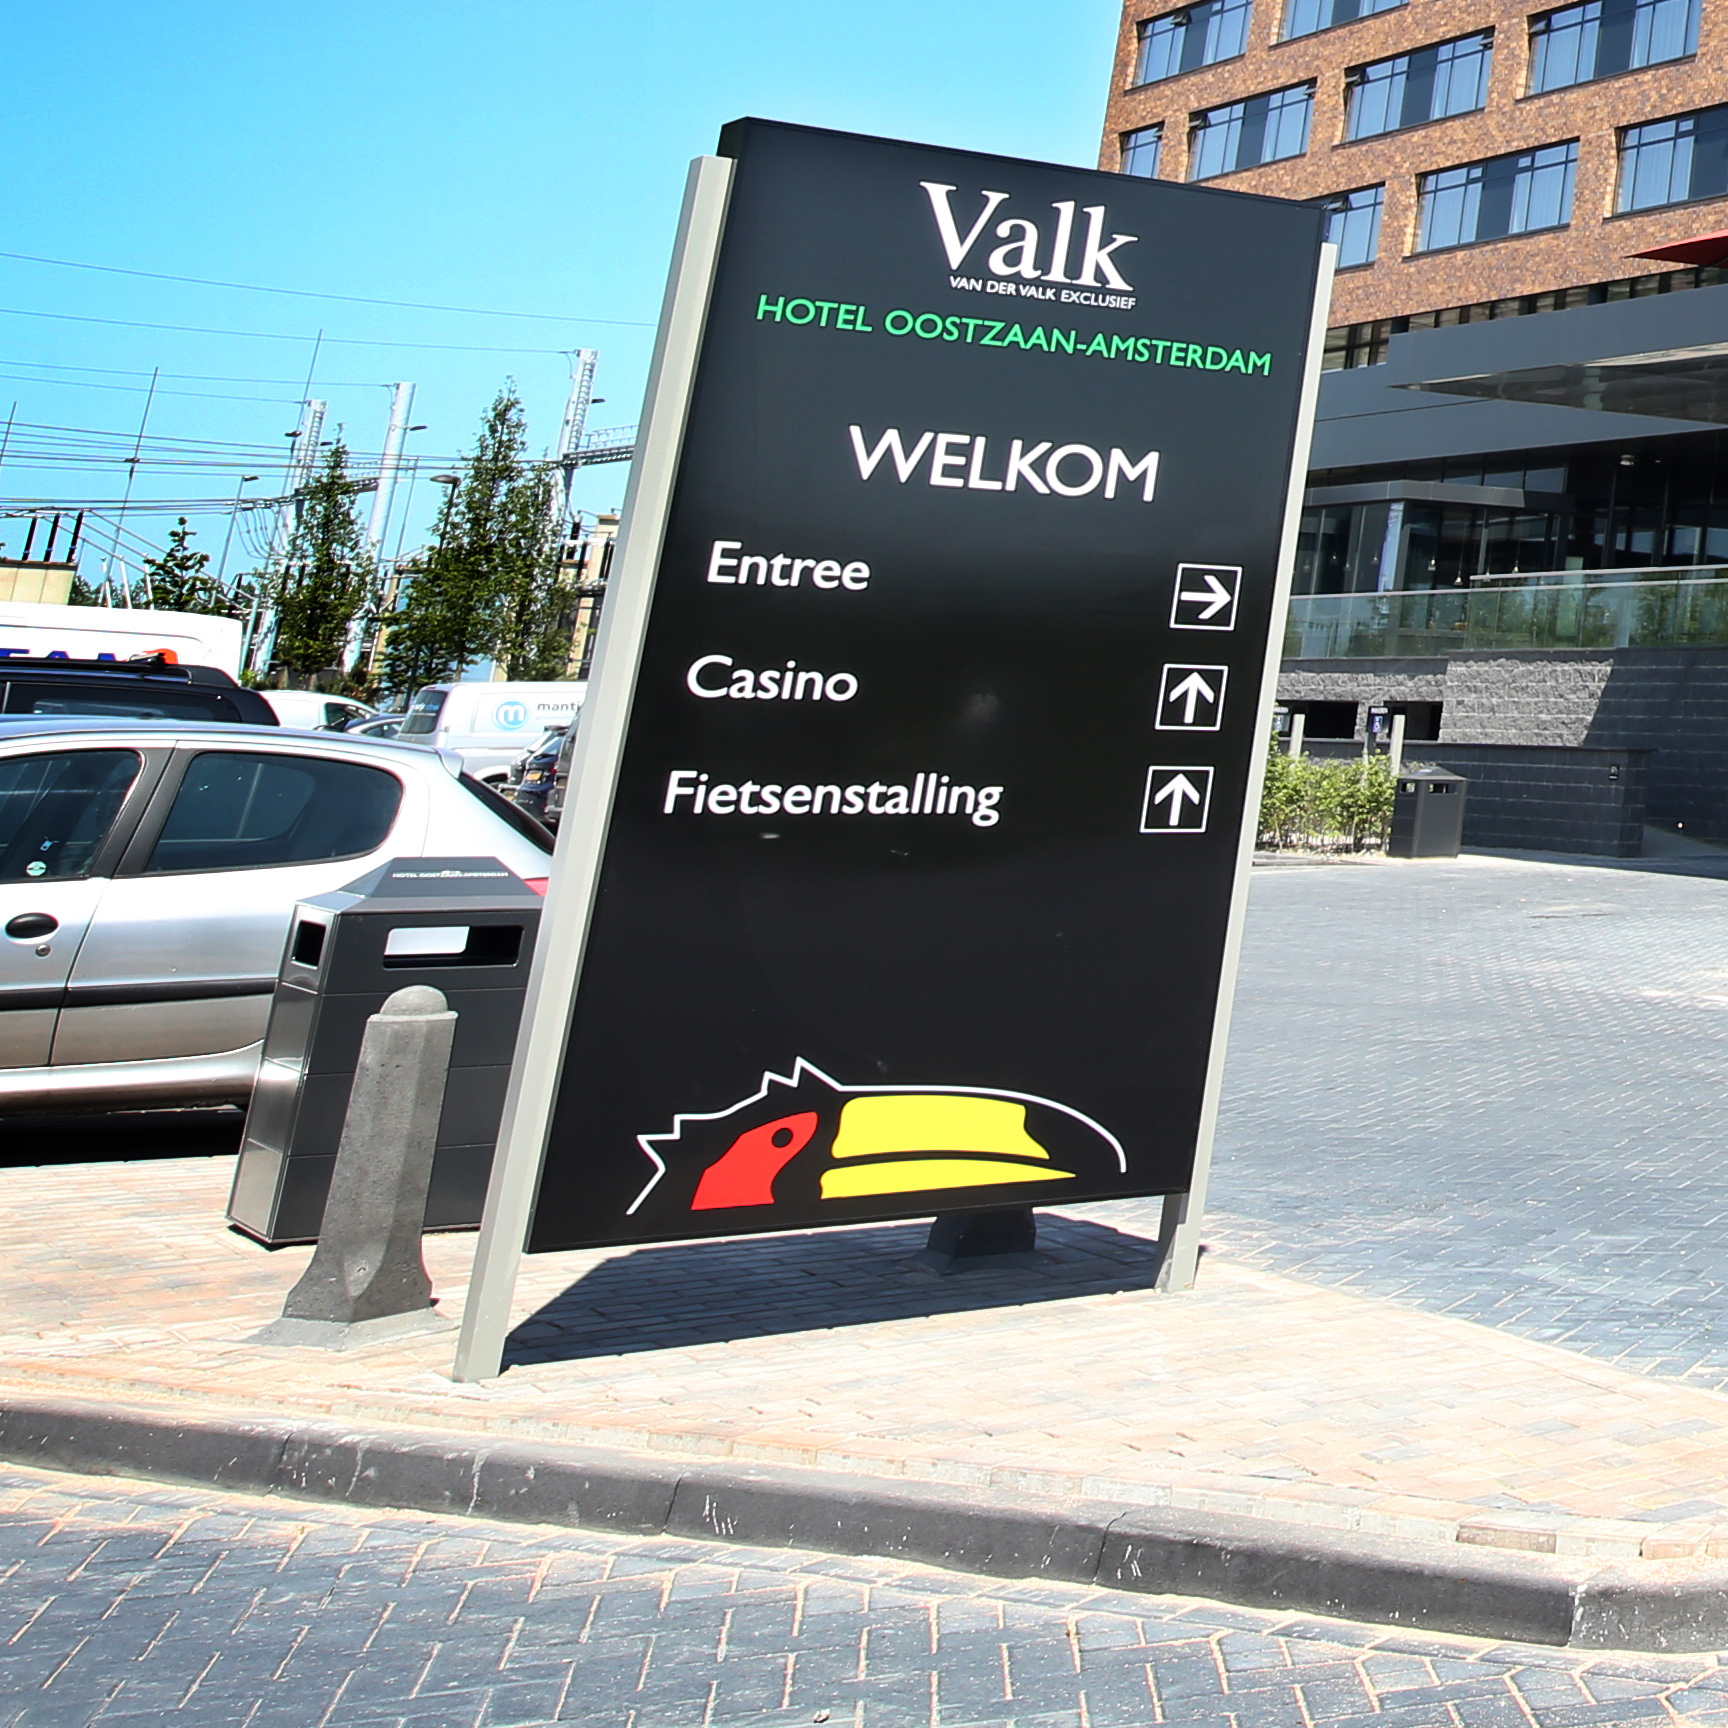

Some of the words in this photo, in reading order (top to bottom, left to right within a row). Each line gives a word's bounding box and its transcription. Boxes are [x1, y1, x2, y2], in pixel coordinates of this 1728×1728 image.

[919, 180, 1139, 292] Valk
[949, 275, 983, 292] VAN
[986, 280, 1016, 296] DER
[1019, 284, 1056, 301] VALK
[1060, 290, 1137, 310] EXCLUSIEF
[755, 294, 874, 333] HOTEL
[883, 310, 1272, 376] OOSTZAAN-AMSTERDAM
[848, 423, 1161, 503] WELKOM
[706, 540, 871, 591] Entree
[685, 654, 859, 702] Casino
[663, 770, 1004, 827] Fietsenstalling
